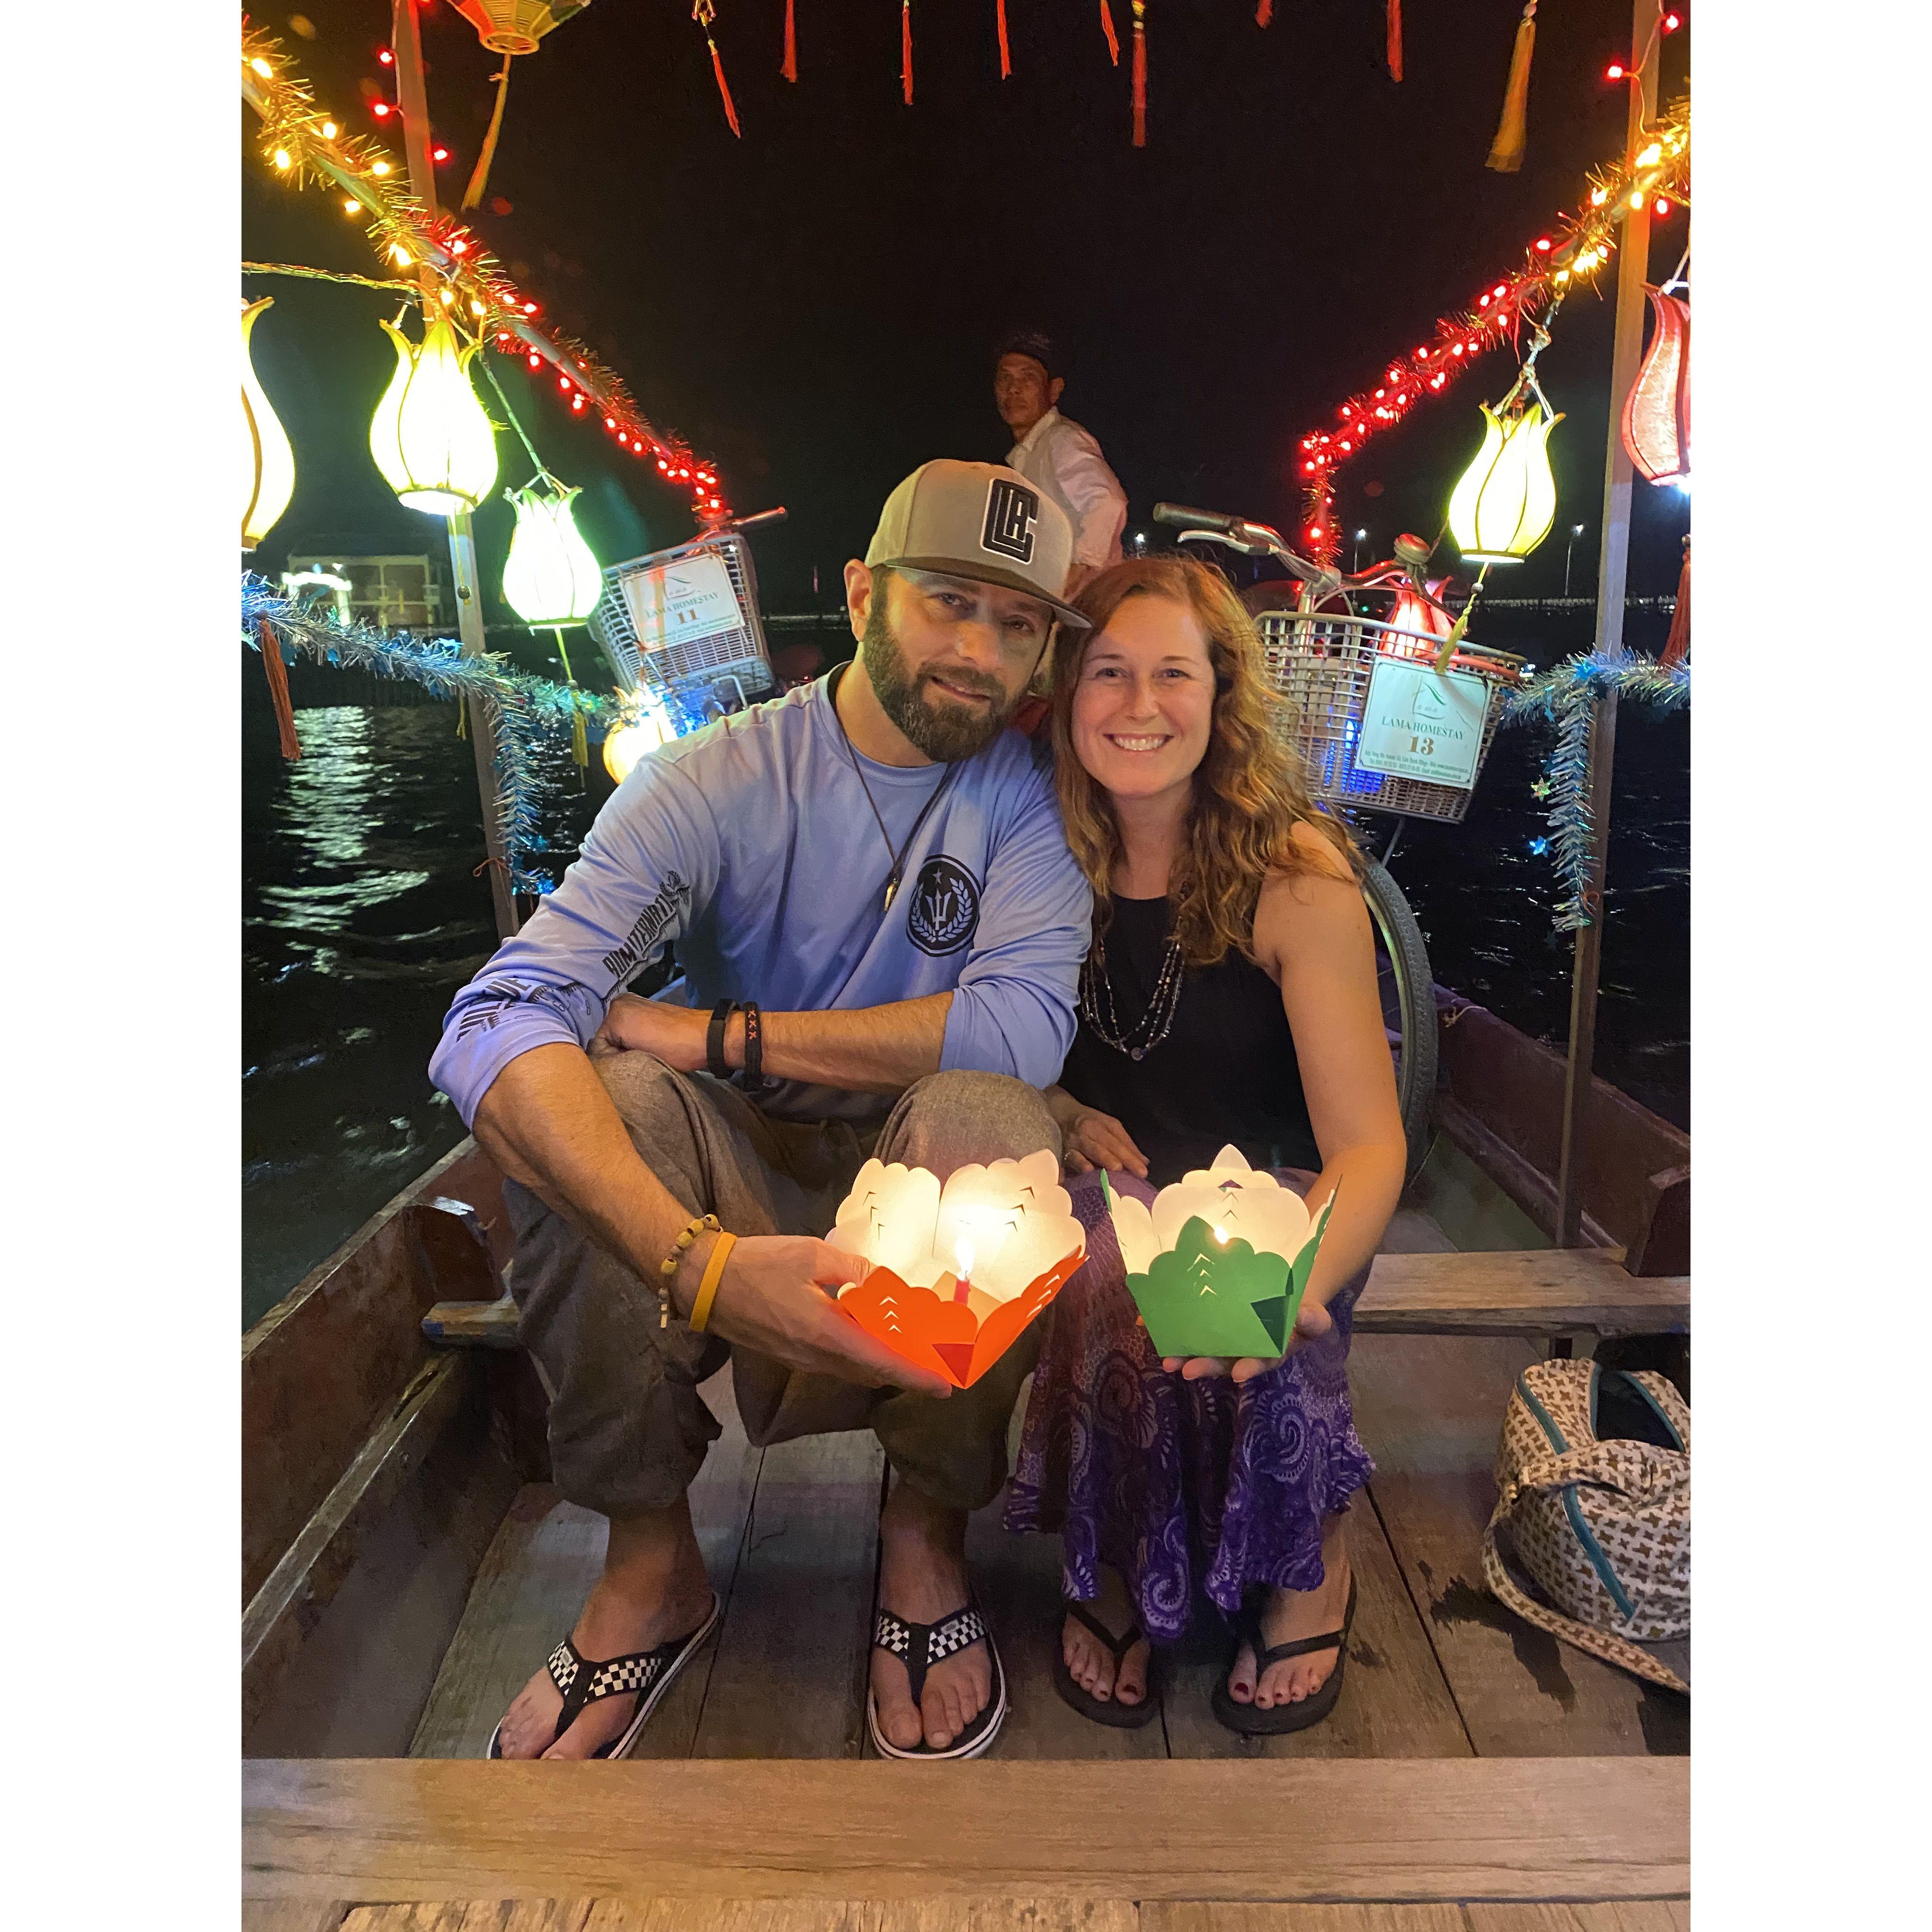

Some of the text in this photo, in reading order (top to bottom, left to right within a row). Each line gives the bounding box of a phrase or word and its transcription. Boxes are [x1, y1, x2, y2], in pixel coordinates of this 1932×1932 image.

[645, 592, 719, 618] LAMA HOMESTAY
[677, 609, 700, 624] 11
[1382, 716, 1465, 740] LAMA HOMESTAY
[1408, 736, 1434, 755] 13
